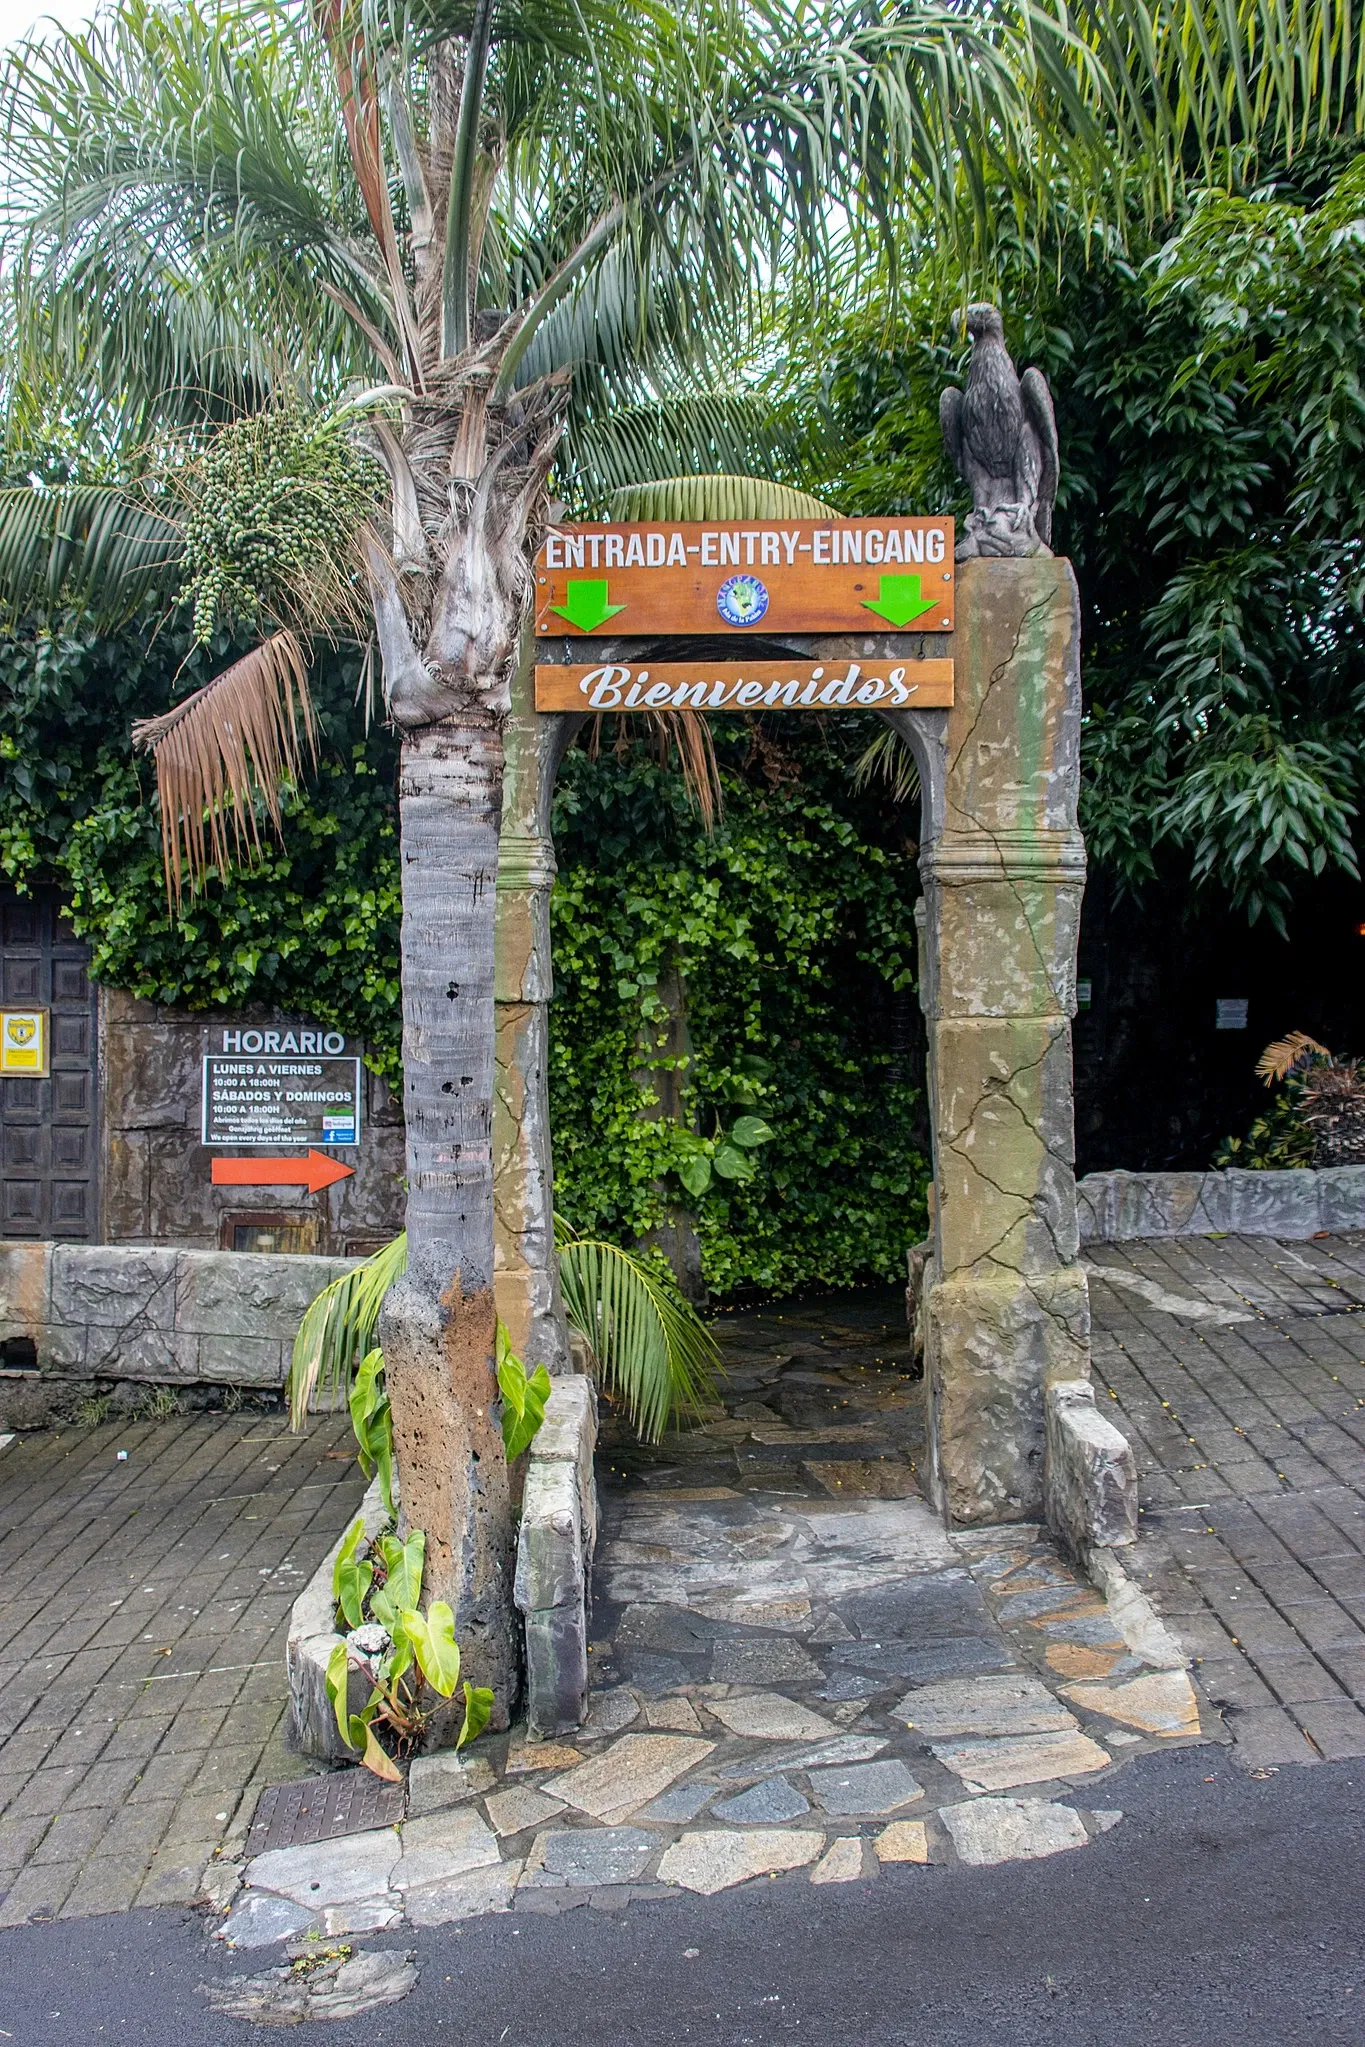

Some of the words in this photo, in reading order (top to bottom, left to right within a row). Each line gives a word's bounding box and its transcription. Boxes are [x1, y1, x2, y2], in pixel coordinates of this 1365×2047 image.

[579, 663, 919, 709] Bienvenidos
[223, 1030, 345, 1055] HORARIO
[213, 1064, 254, 1075] LUNES
[257, 1065, 266, 1075] A
[269, 1065, 322, 1075] VIERNES
[213, 1078, 238, 1087] 10:00
[239, 1079, 247, 1087] A
[249, 1079, 280, 1087] 18:00H
[212, 1089, 271, 1101] SÁBADOS
[274, 1091, 283, 1102] Y
[286, 1091, 352, 1102] DOMINGOS
[212, 1105, 238, 1113] 10:00
[239, 1106, 247, 1114] A
[249, 1105, 280, 1114] 18:00H
[210, 1134, 222, 1142] We
